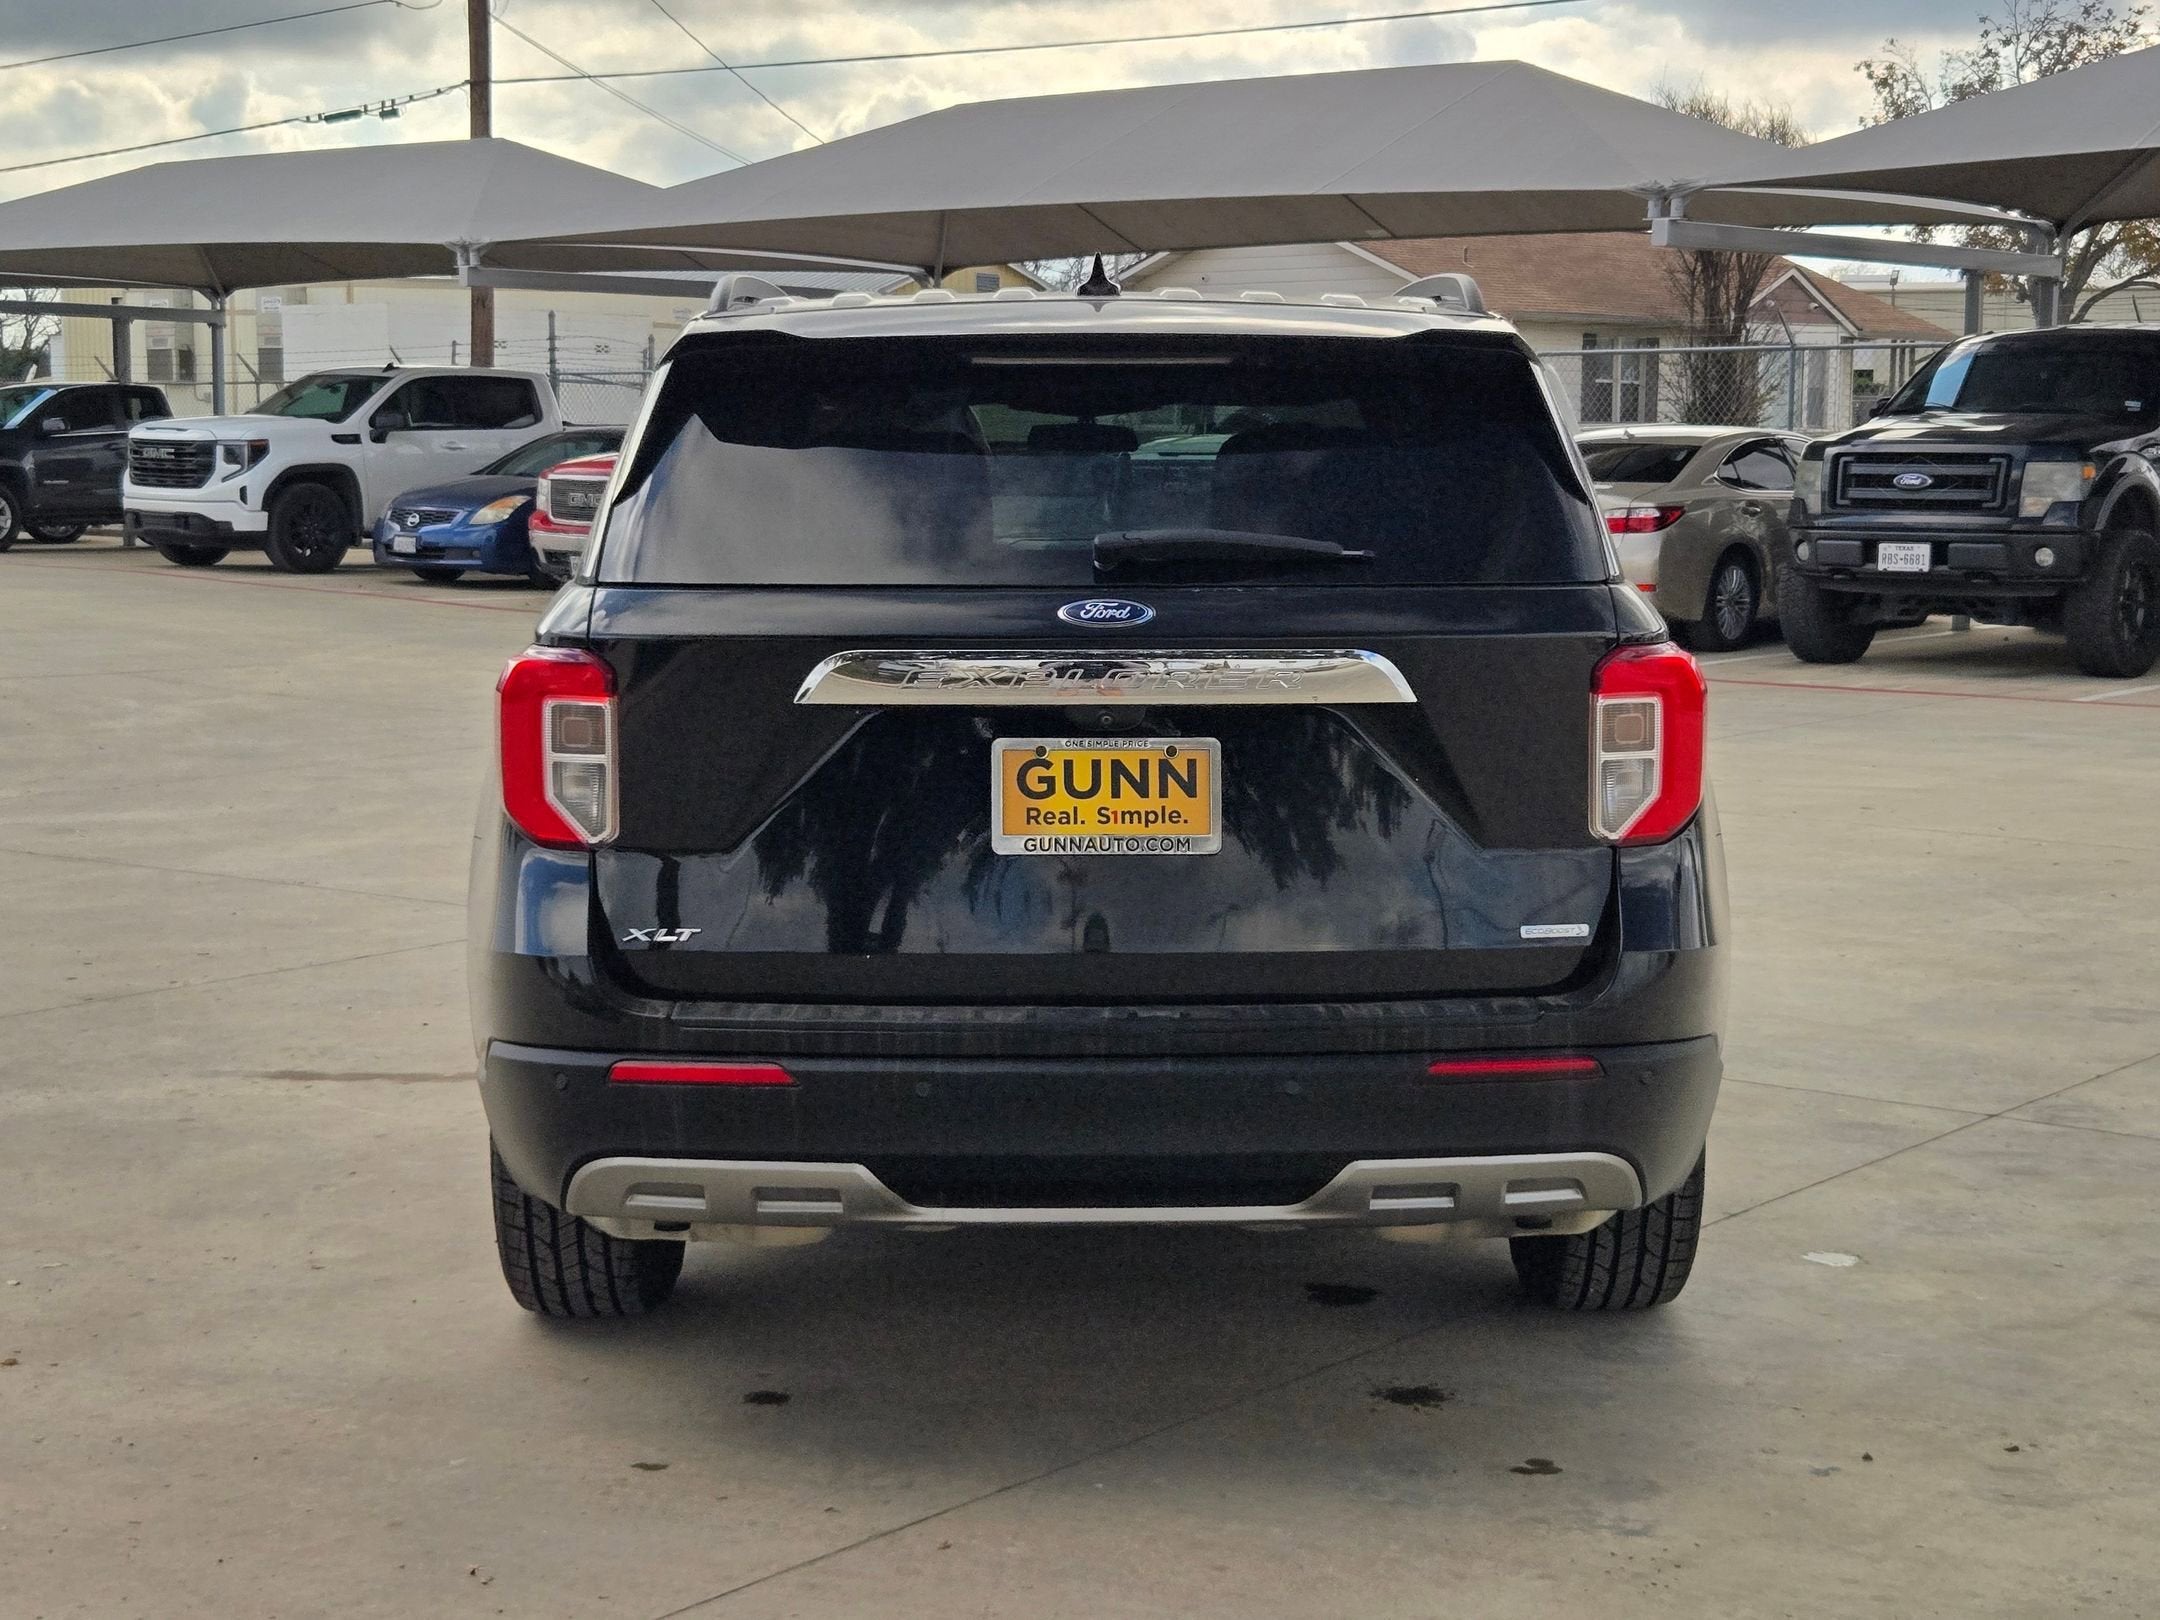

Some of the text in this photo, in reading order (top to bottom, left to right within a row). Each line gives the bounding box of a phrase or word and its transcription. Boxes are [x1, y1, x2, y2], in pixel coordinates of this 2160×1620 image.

[143, 447, 175, 459] GMC
[1900, 474, 1921, 485] Ford
[1080, 602, 1131, 619] Ford
[899, 667, 1302, 690] EXPLORER
[1065, 740, 1149, 748] ONE SIMPLE PRICE
[1016, 758, 1197, 800] GUNN
[1026, 806, 1086, 825] Real.
[1024, 837, 1191, 852] GUNNAUTO.COM
[622, 928, 702, 942] XLT
